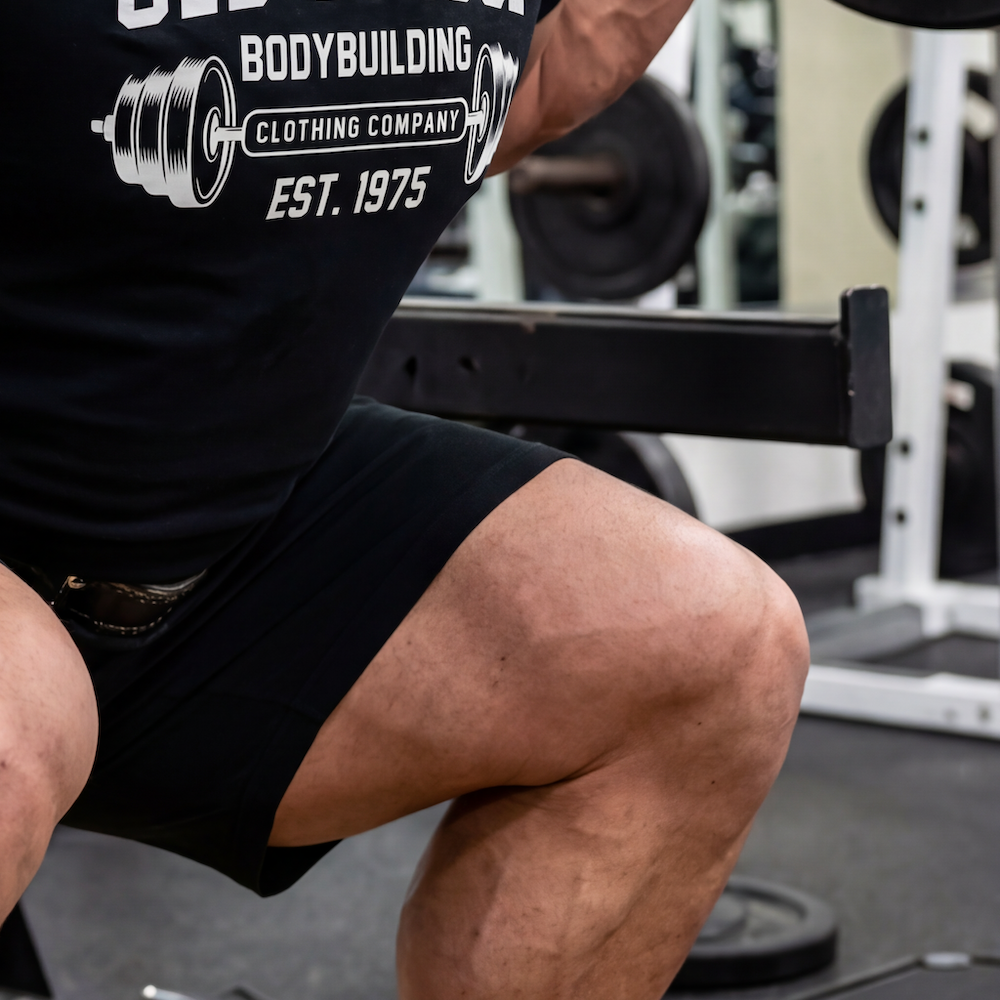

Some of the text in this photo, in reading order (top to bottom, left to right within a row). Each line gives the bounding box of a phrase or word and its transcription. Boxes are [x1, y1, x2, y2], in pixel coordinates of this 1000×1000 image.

[240, 25, 472, 82] BODYBUILDING
[255, 109, 460, 144] CLOTHING COMPANY
[265, 165, 432, 221] EST. 1975
